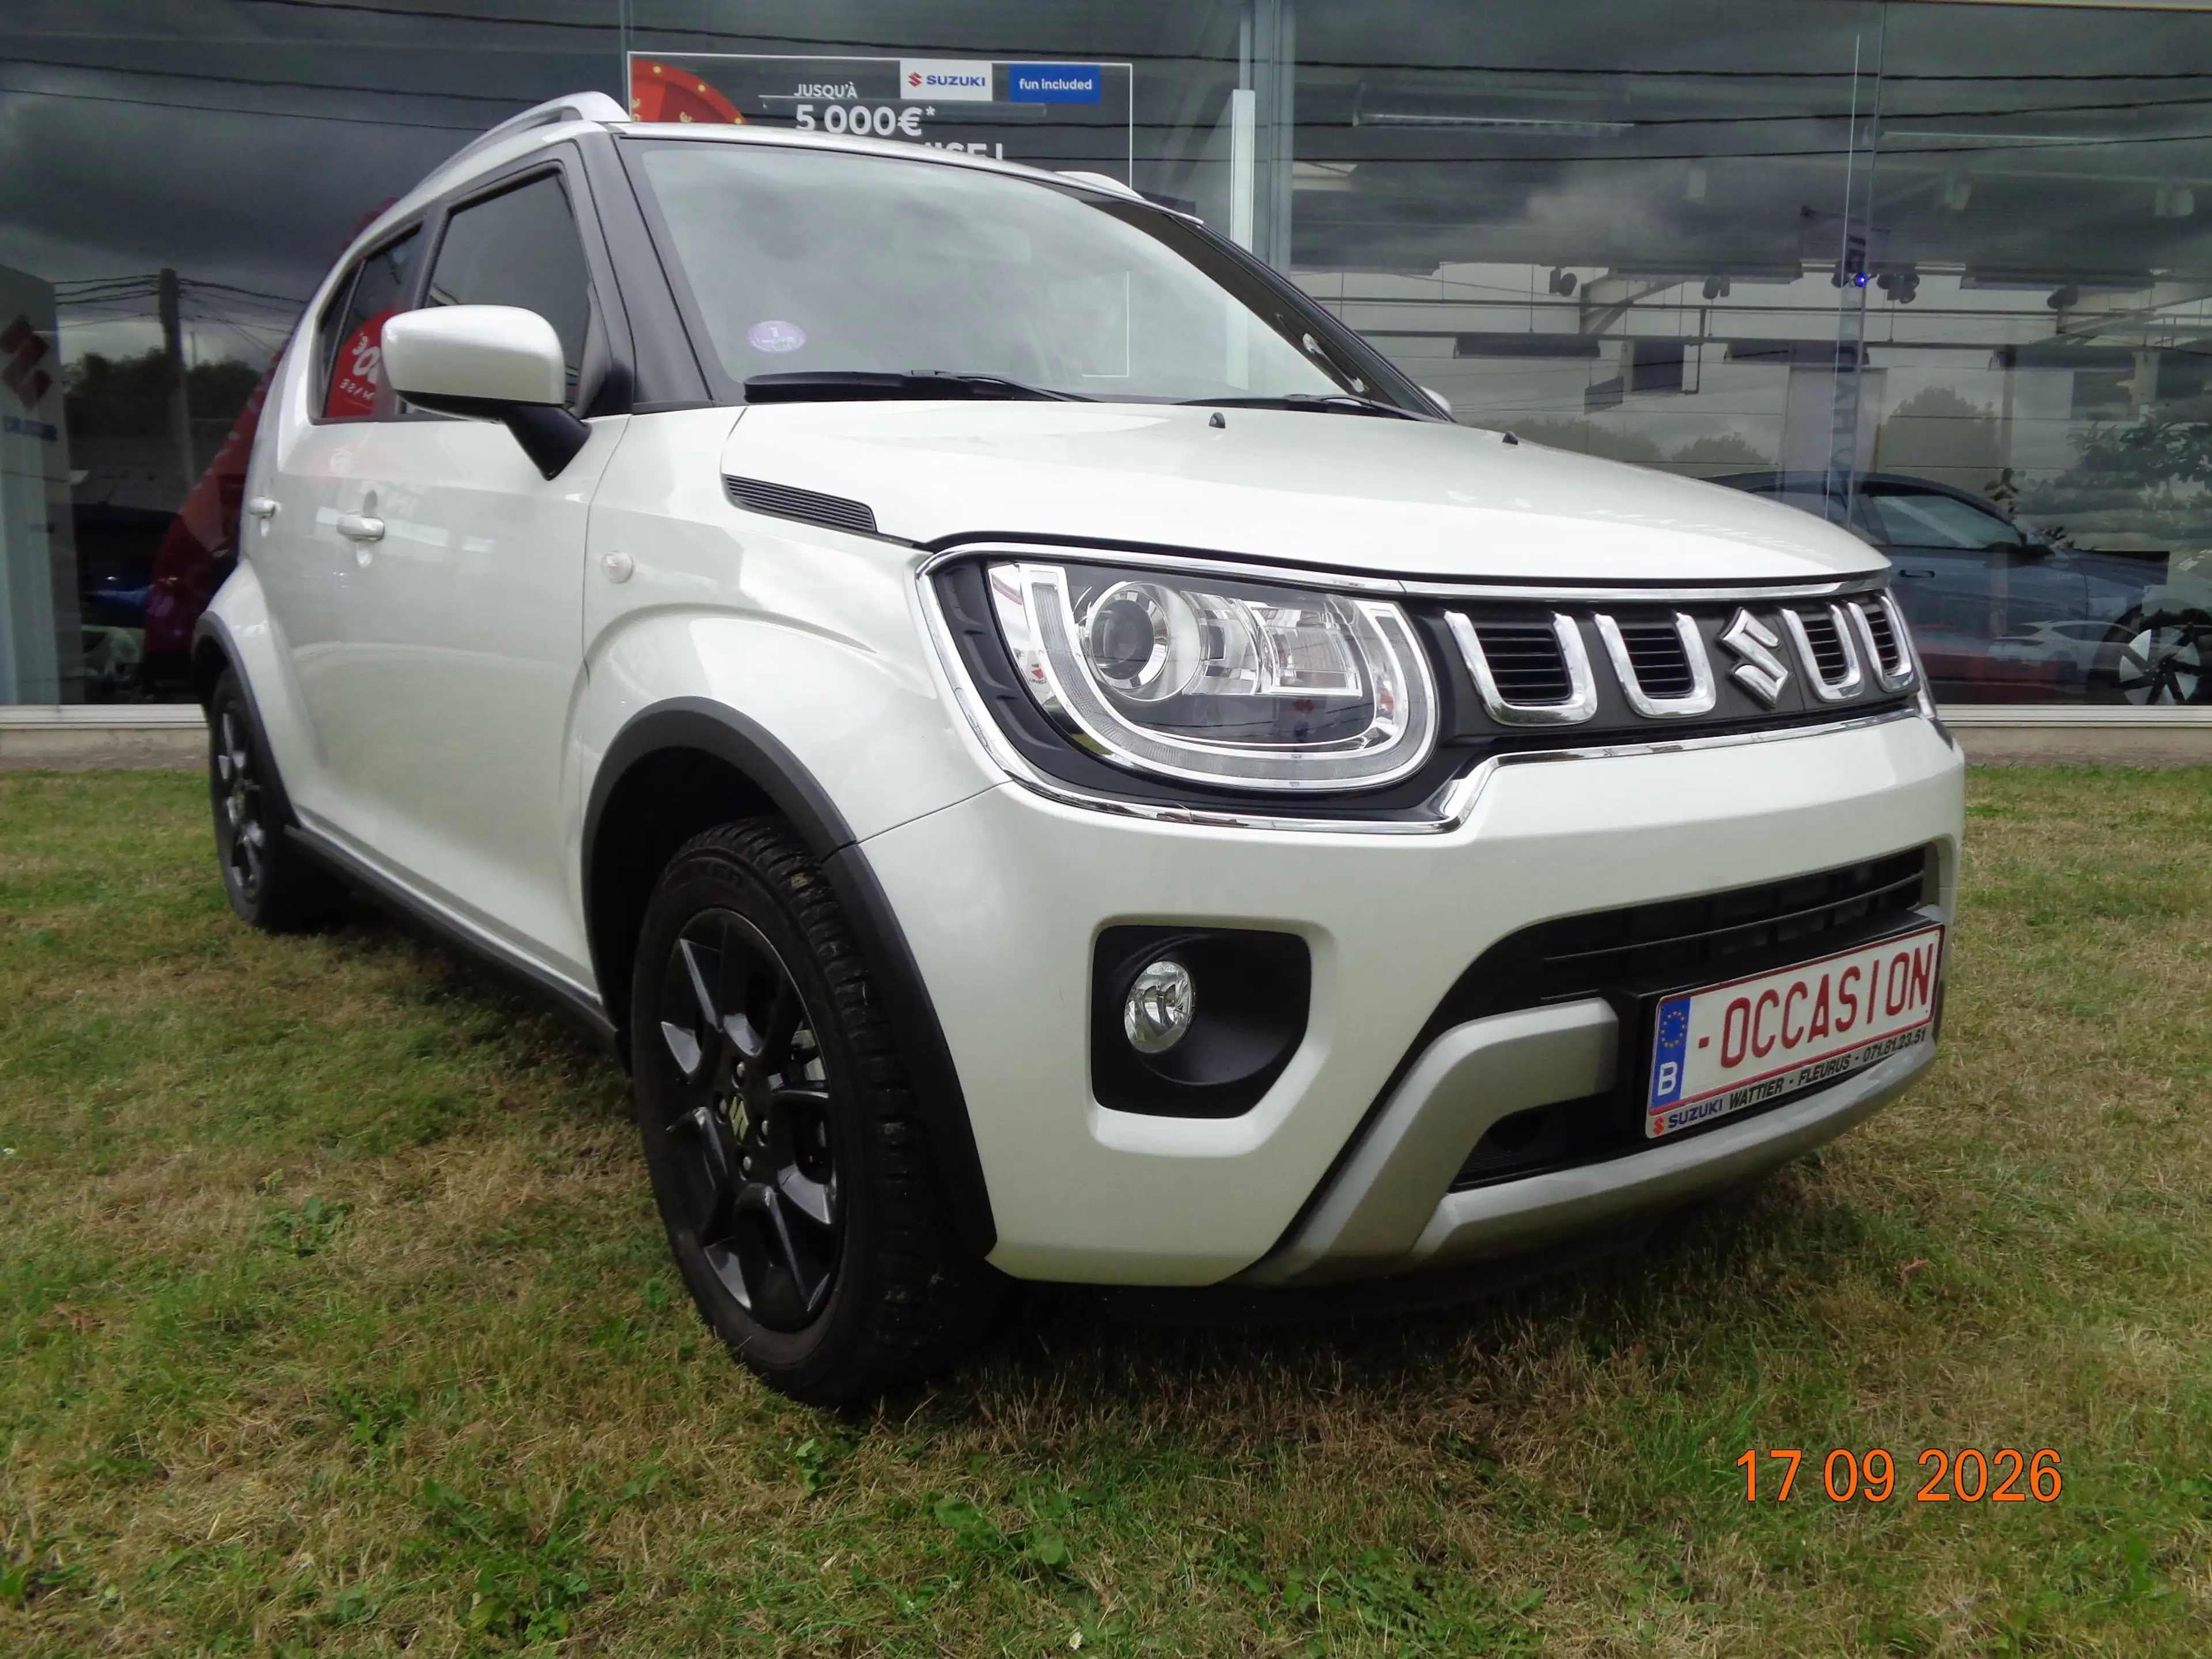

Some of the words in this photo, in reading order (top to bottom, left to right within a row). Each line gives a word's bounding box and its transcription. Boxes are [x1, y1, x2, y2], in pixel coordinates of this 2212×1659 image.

[926, 75, 986, 87] SUZUKI
[1018, 78, 1039, 89] fun
[1041, 78, 1092, 90] included
[1657, 1061, 1677, 1096] B
[1668, 1099, 1724, 1128] SUZUKI
[1729, 1076, 1784, 1109] WATTIER
[1798, 1054, 1851, 1086] FLEURUS
